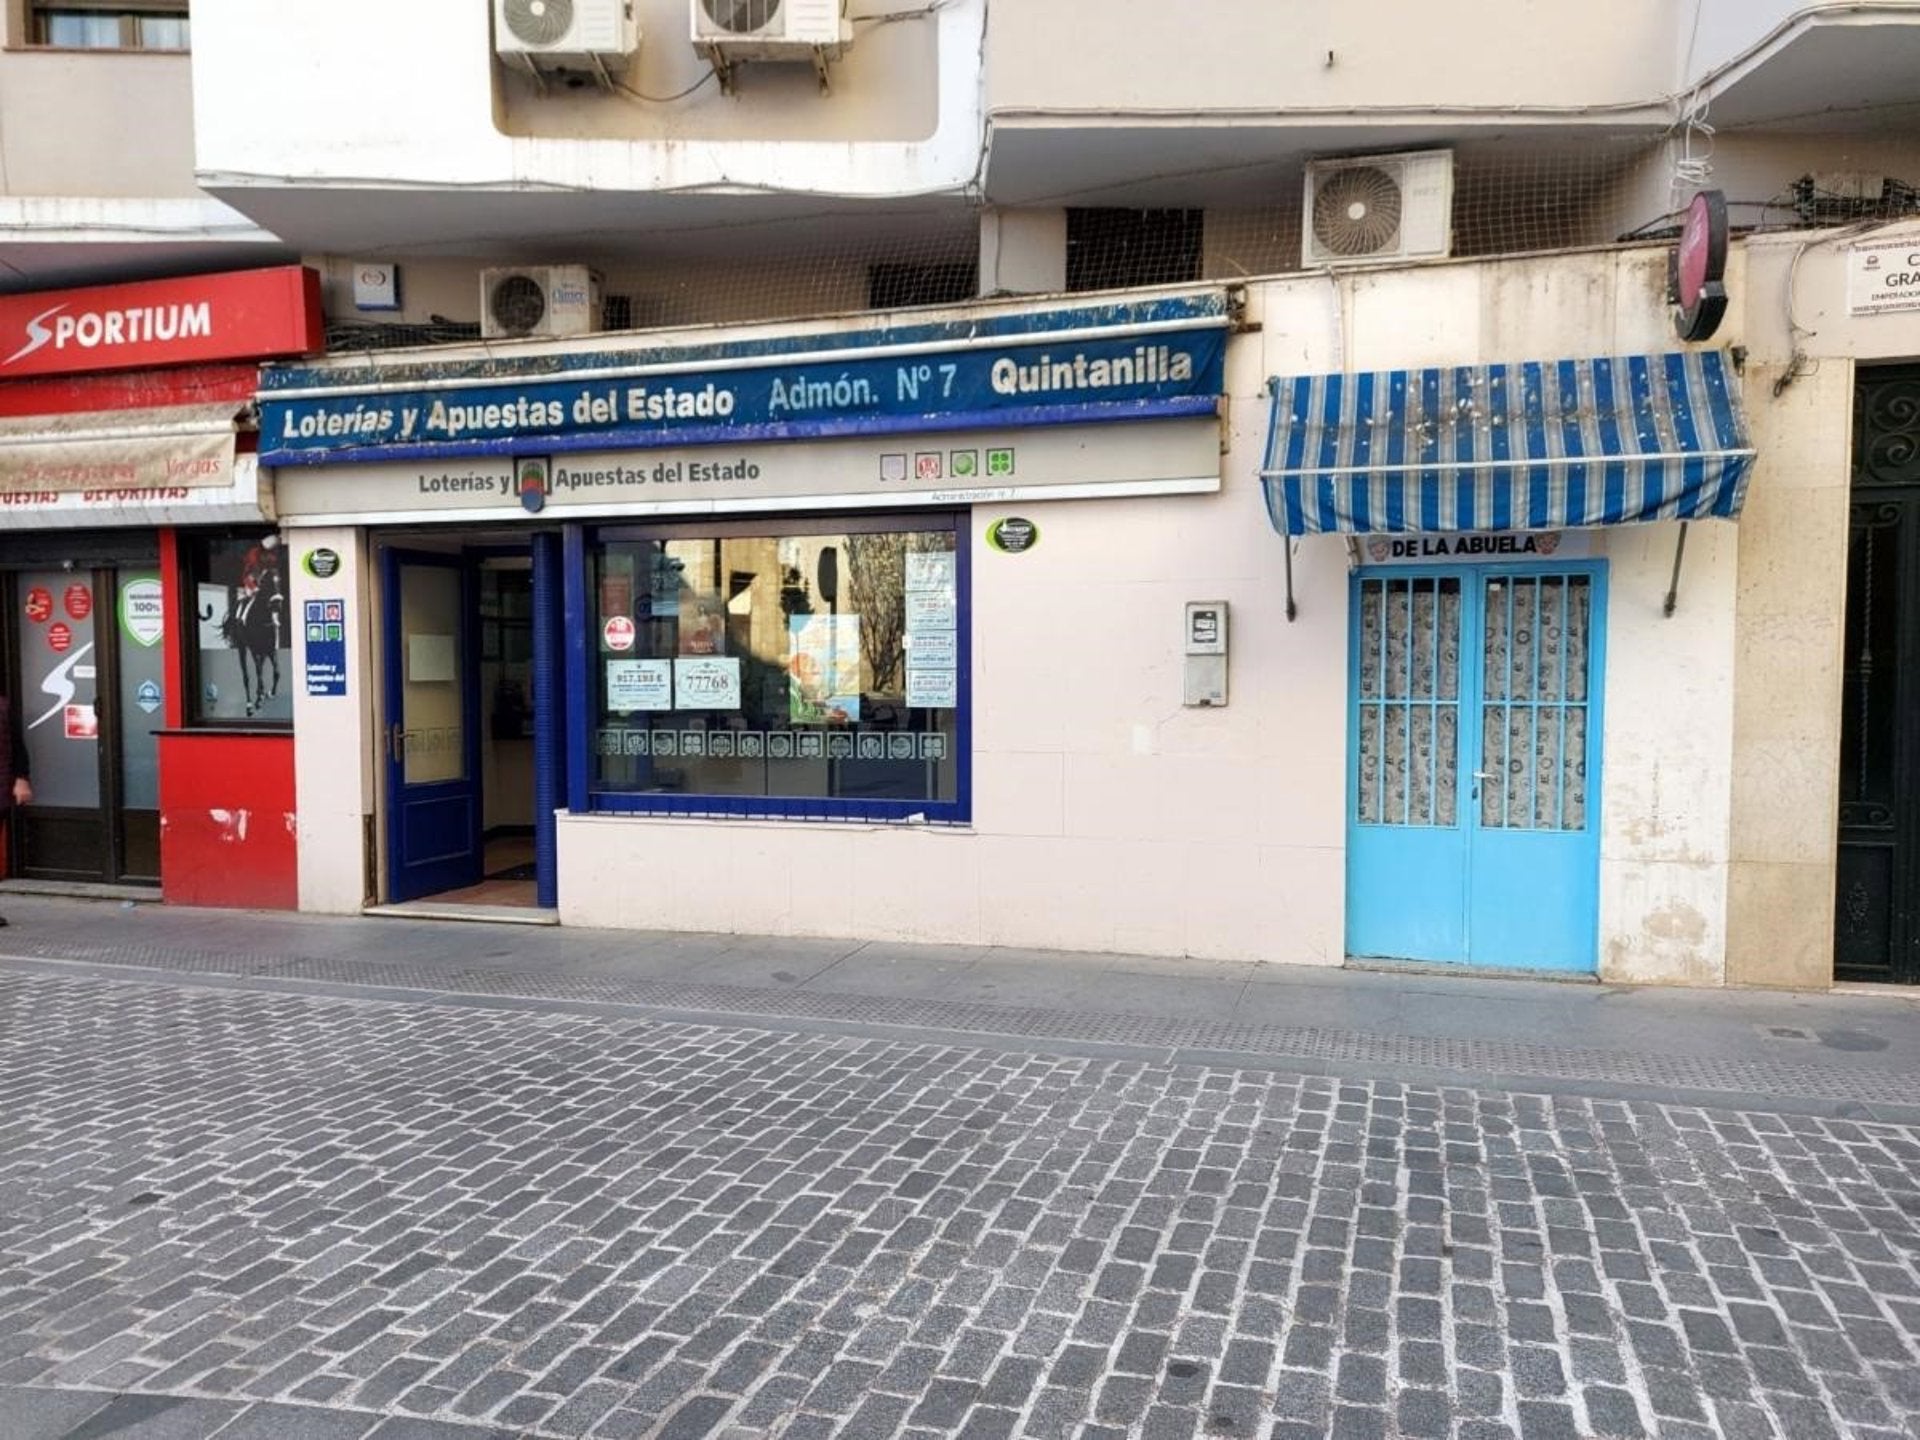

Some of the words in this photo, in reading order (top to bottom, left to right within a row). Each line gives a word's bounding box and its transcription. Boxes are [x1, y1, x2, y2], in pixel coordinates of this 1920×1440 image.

[2, 302, 211, 365] SPORTIUM
[283, 404, 394, 438] Loterías
[402, 406, 418, 437] y
[426, 397, 564, 437] Apuestas
[572, 389, 618, 423] del
[627, 384, 734, 421] Estado
[768, 372, 879, 411] Admón.
[939, 363, 957, 398] 7
[991, 345, 1192, 395] Quintanilla
[419, 472, 494, 493] Loterías
[500, 475, 510, 495] y
[555, 467, 647, 490] Apuestas
[652, 462, 682, 483] del
[689, 459, 760, 482] Estado
[1392, 540, 1418, 558] DE
[1423, 537, 1451, 556] LA
[1454, 535, 1538, 554] ABUELA
[687, 675, 729, 690] 77768
